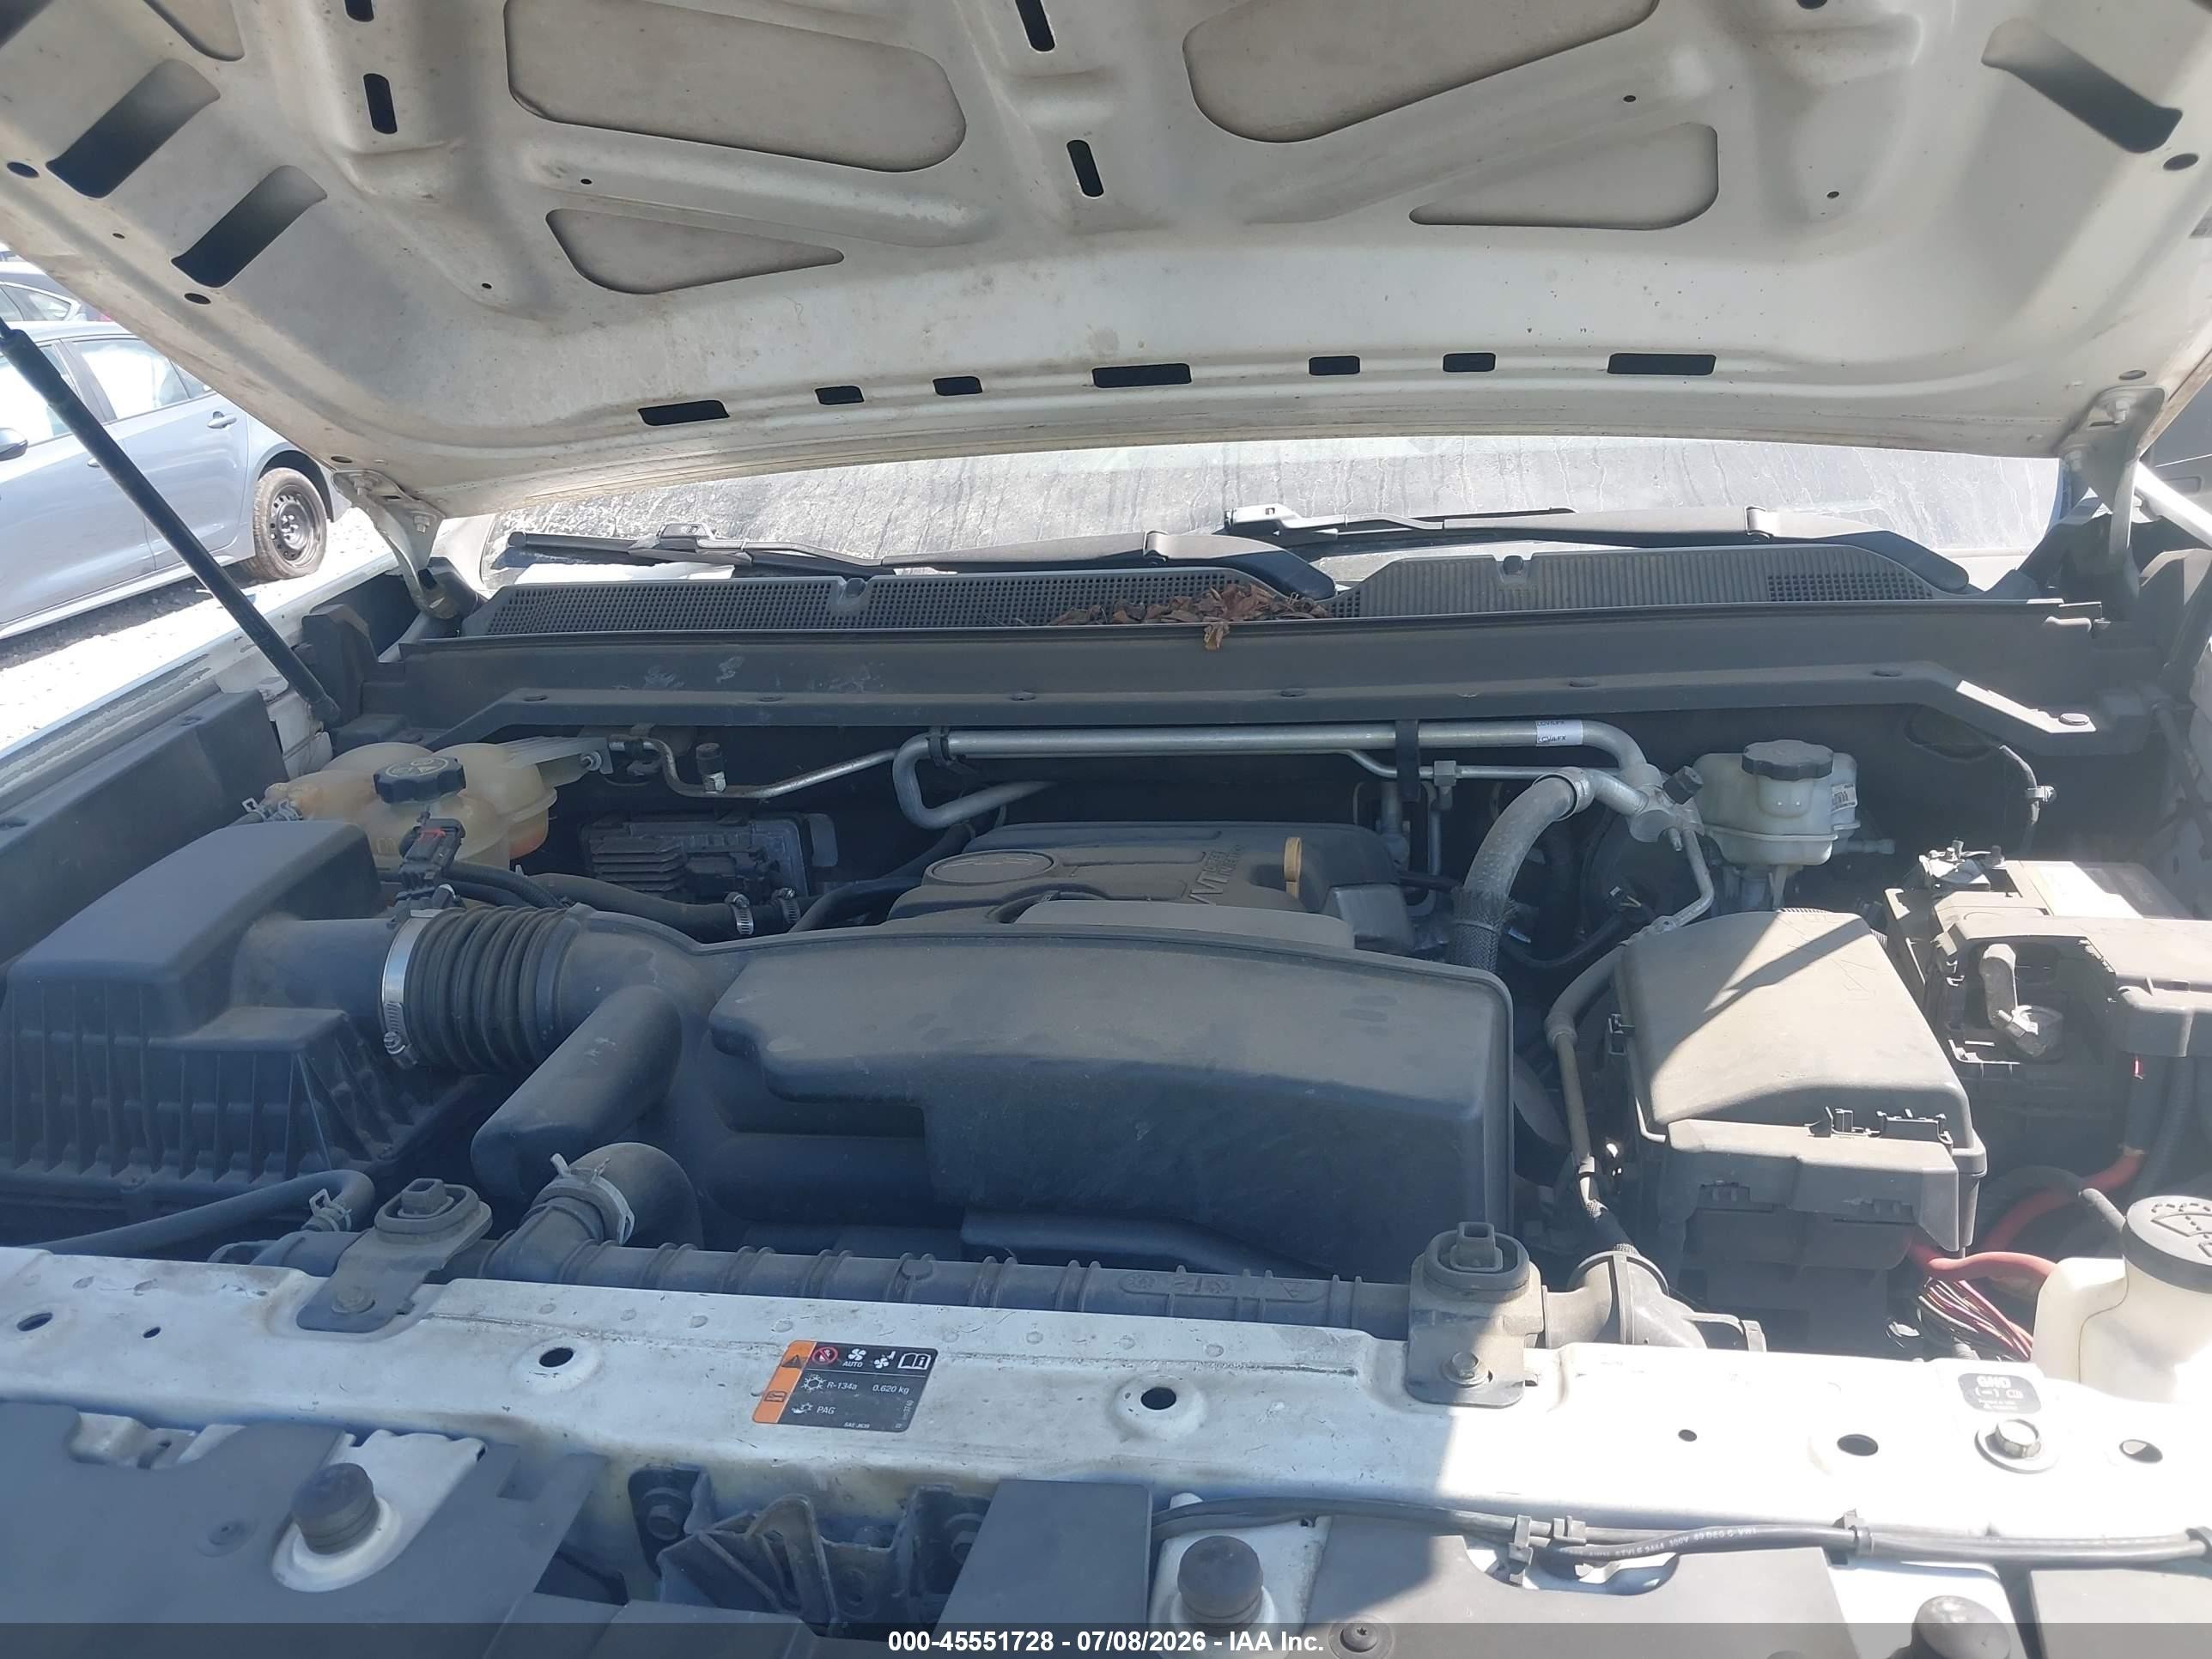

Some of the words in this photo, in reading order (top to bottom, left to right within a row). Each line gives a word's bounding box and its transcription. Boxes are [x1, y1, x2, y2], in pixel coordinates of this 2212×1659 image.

[826, 1382, 858, 1390] R-134a
[872, 1384, 897, 1393] 0.620
[898, 1386, 910, 1395] kg
[817, 1406, 836, 1414] PAG
[1706, 1529, 1725, 1539] DEG
